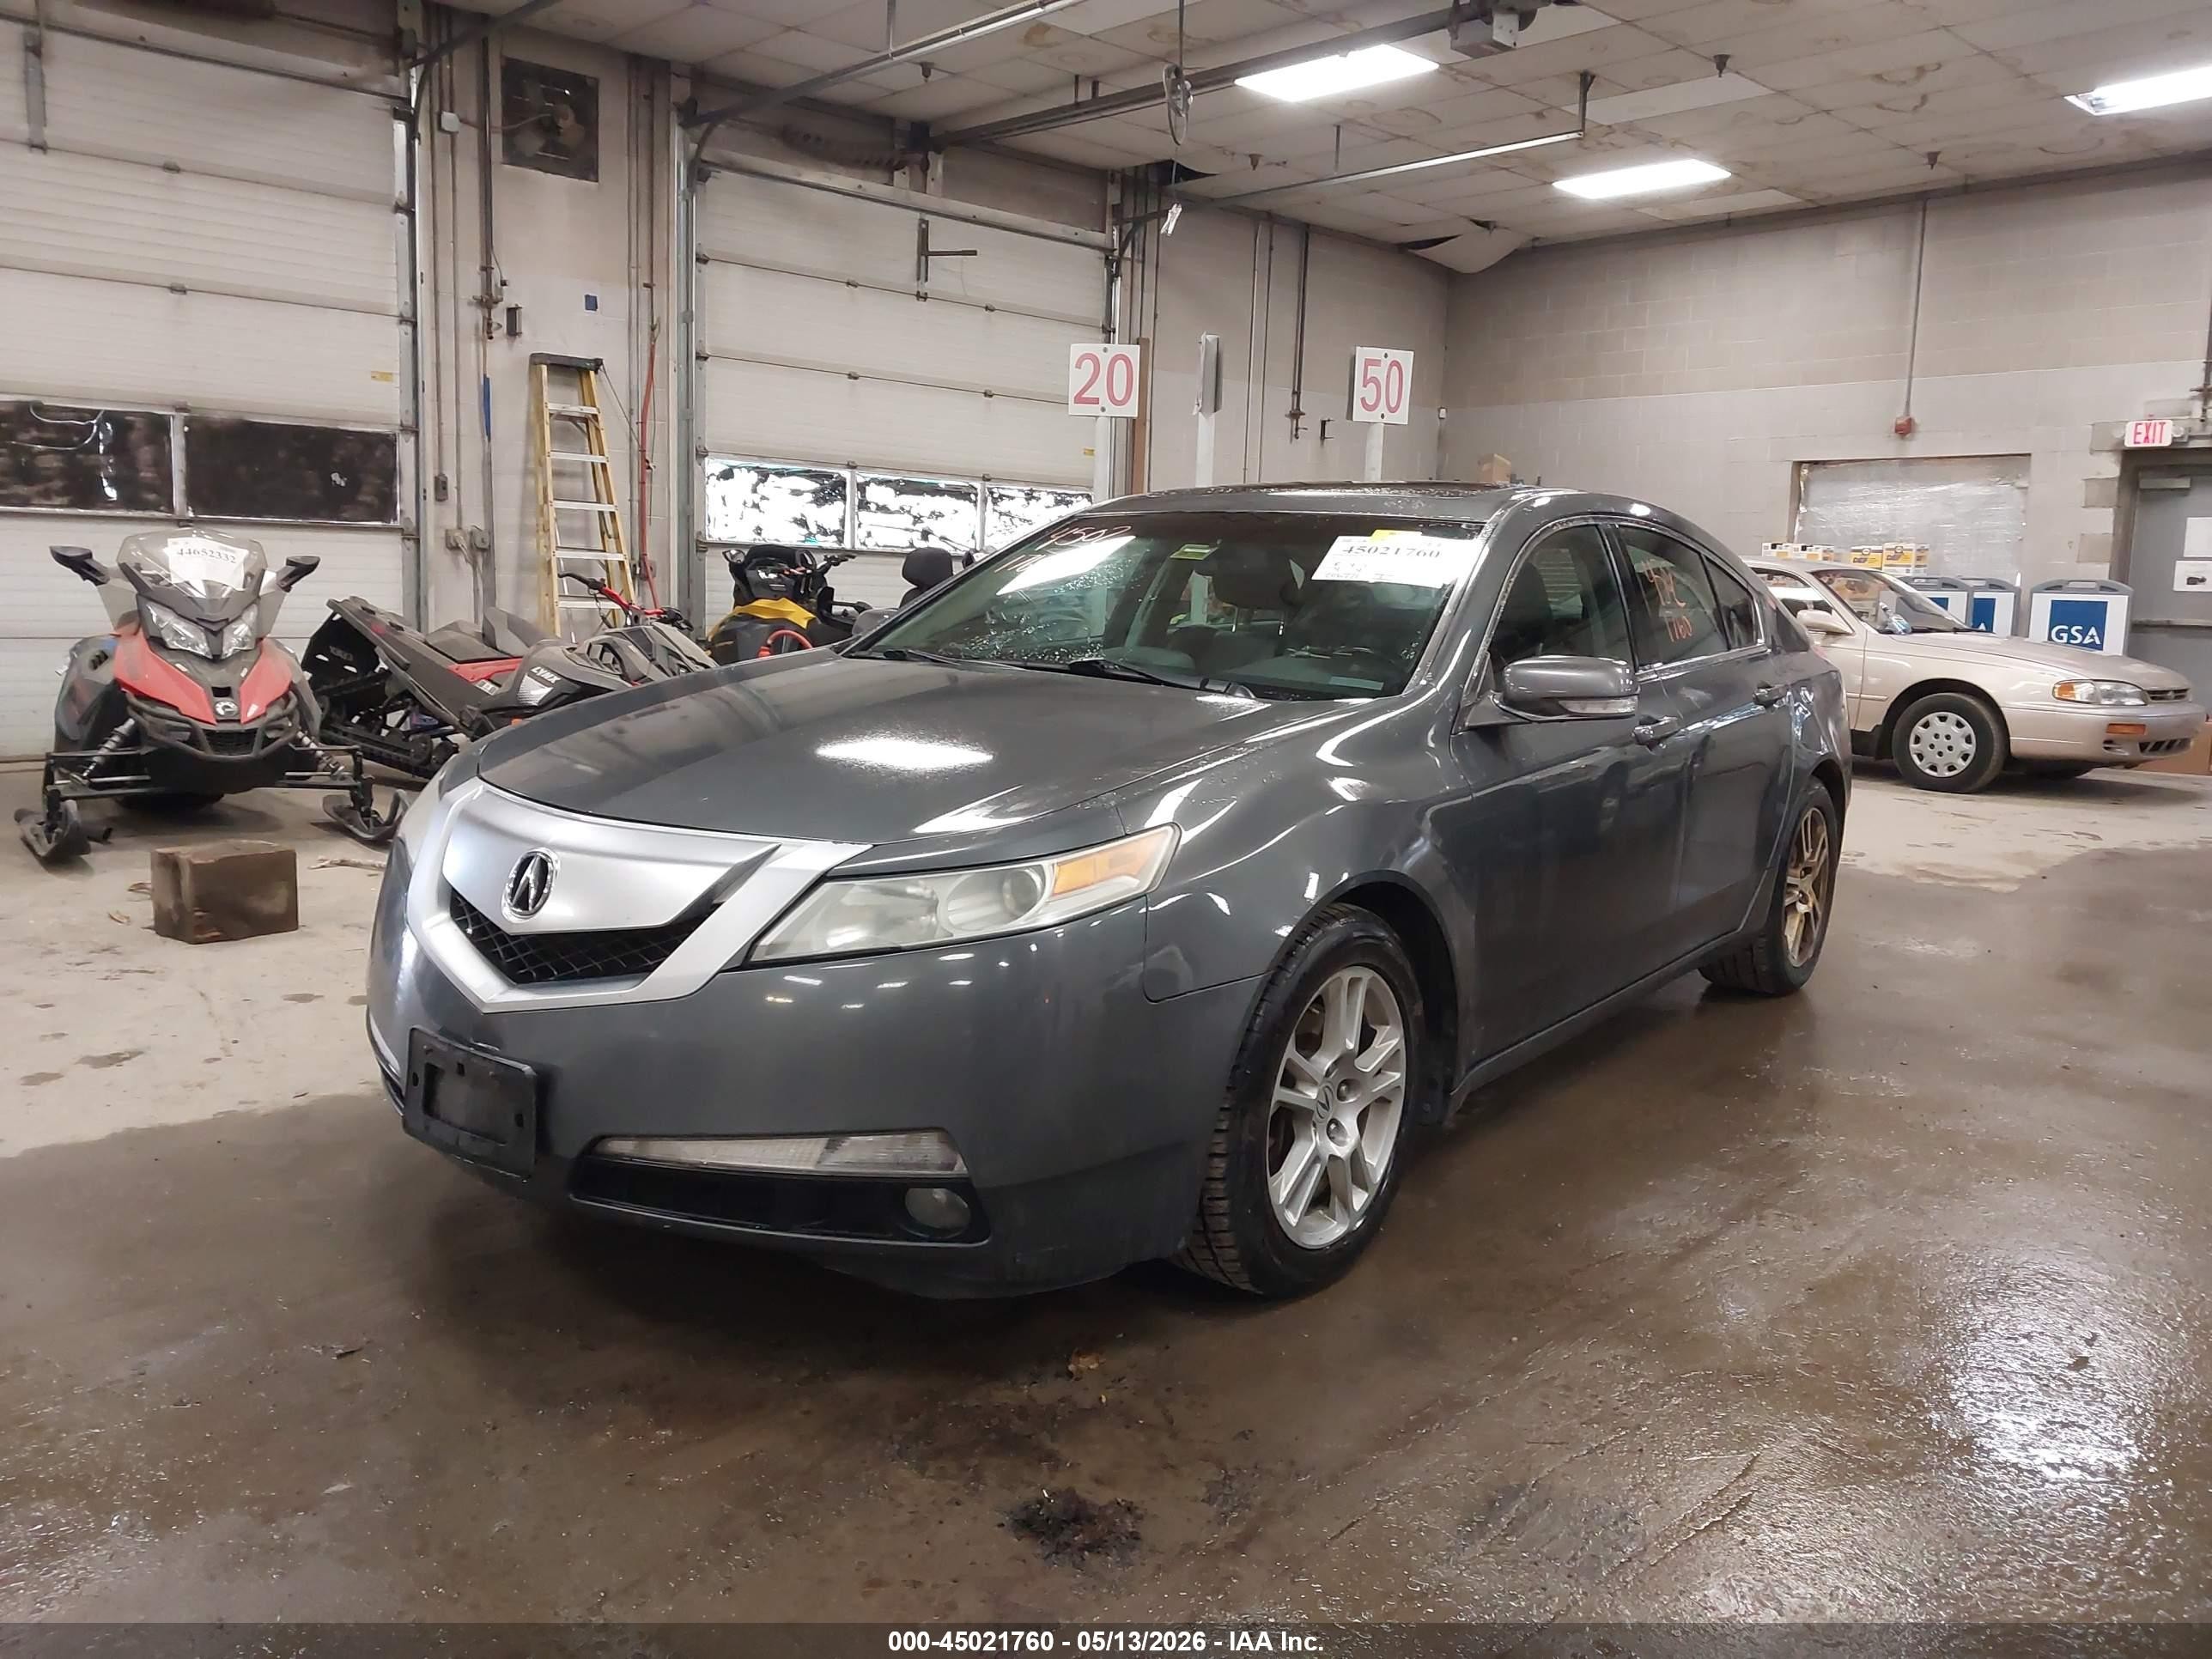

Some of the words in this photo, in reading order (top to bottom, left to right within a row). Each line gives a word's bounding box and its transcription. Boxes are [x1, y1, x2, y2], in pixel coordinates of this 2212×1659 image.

[1073, 352, 1134, 406] 20
[1360, 358, 1404, 414] 50
[2133, 422, 2166, 445] EXIT
[1342, 545, 1441, 558] 45021760
[2051, 624, 2102, 645] GSA
[531, 666, 562, 684] LYNX
